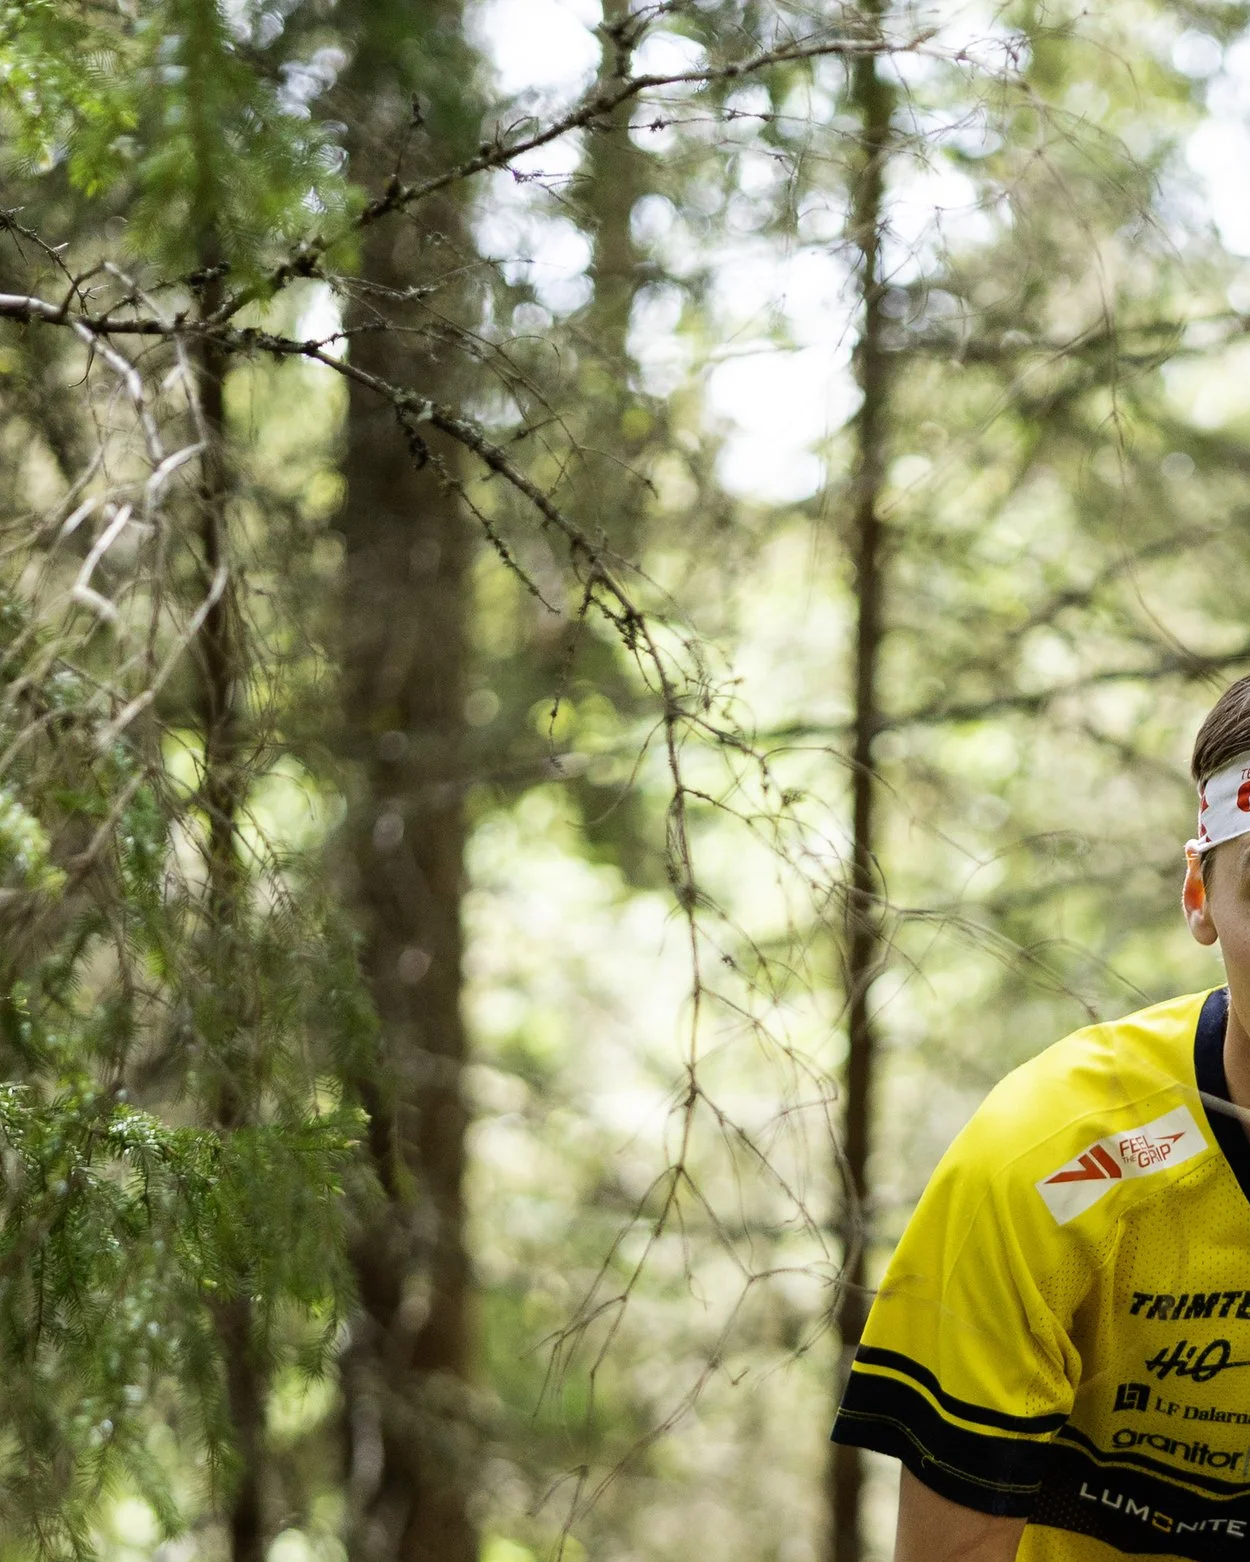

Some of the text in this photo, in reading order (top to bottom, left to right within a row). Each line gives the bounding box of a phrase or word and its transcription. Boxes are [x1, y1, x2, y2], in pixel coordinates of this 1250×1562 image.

[1119, 1134, 1155, 1157] FEEL
[1137, 1143, 1172, 1168] GRIP
[1121, 1152, 1137, 1164] THE
[1155, 1396, 1180, 1415] LF
[1112, 1428, 1244, 1471] granitor
[1079, 1481, 1248, 1538] LUMONITE
